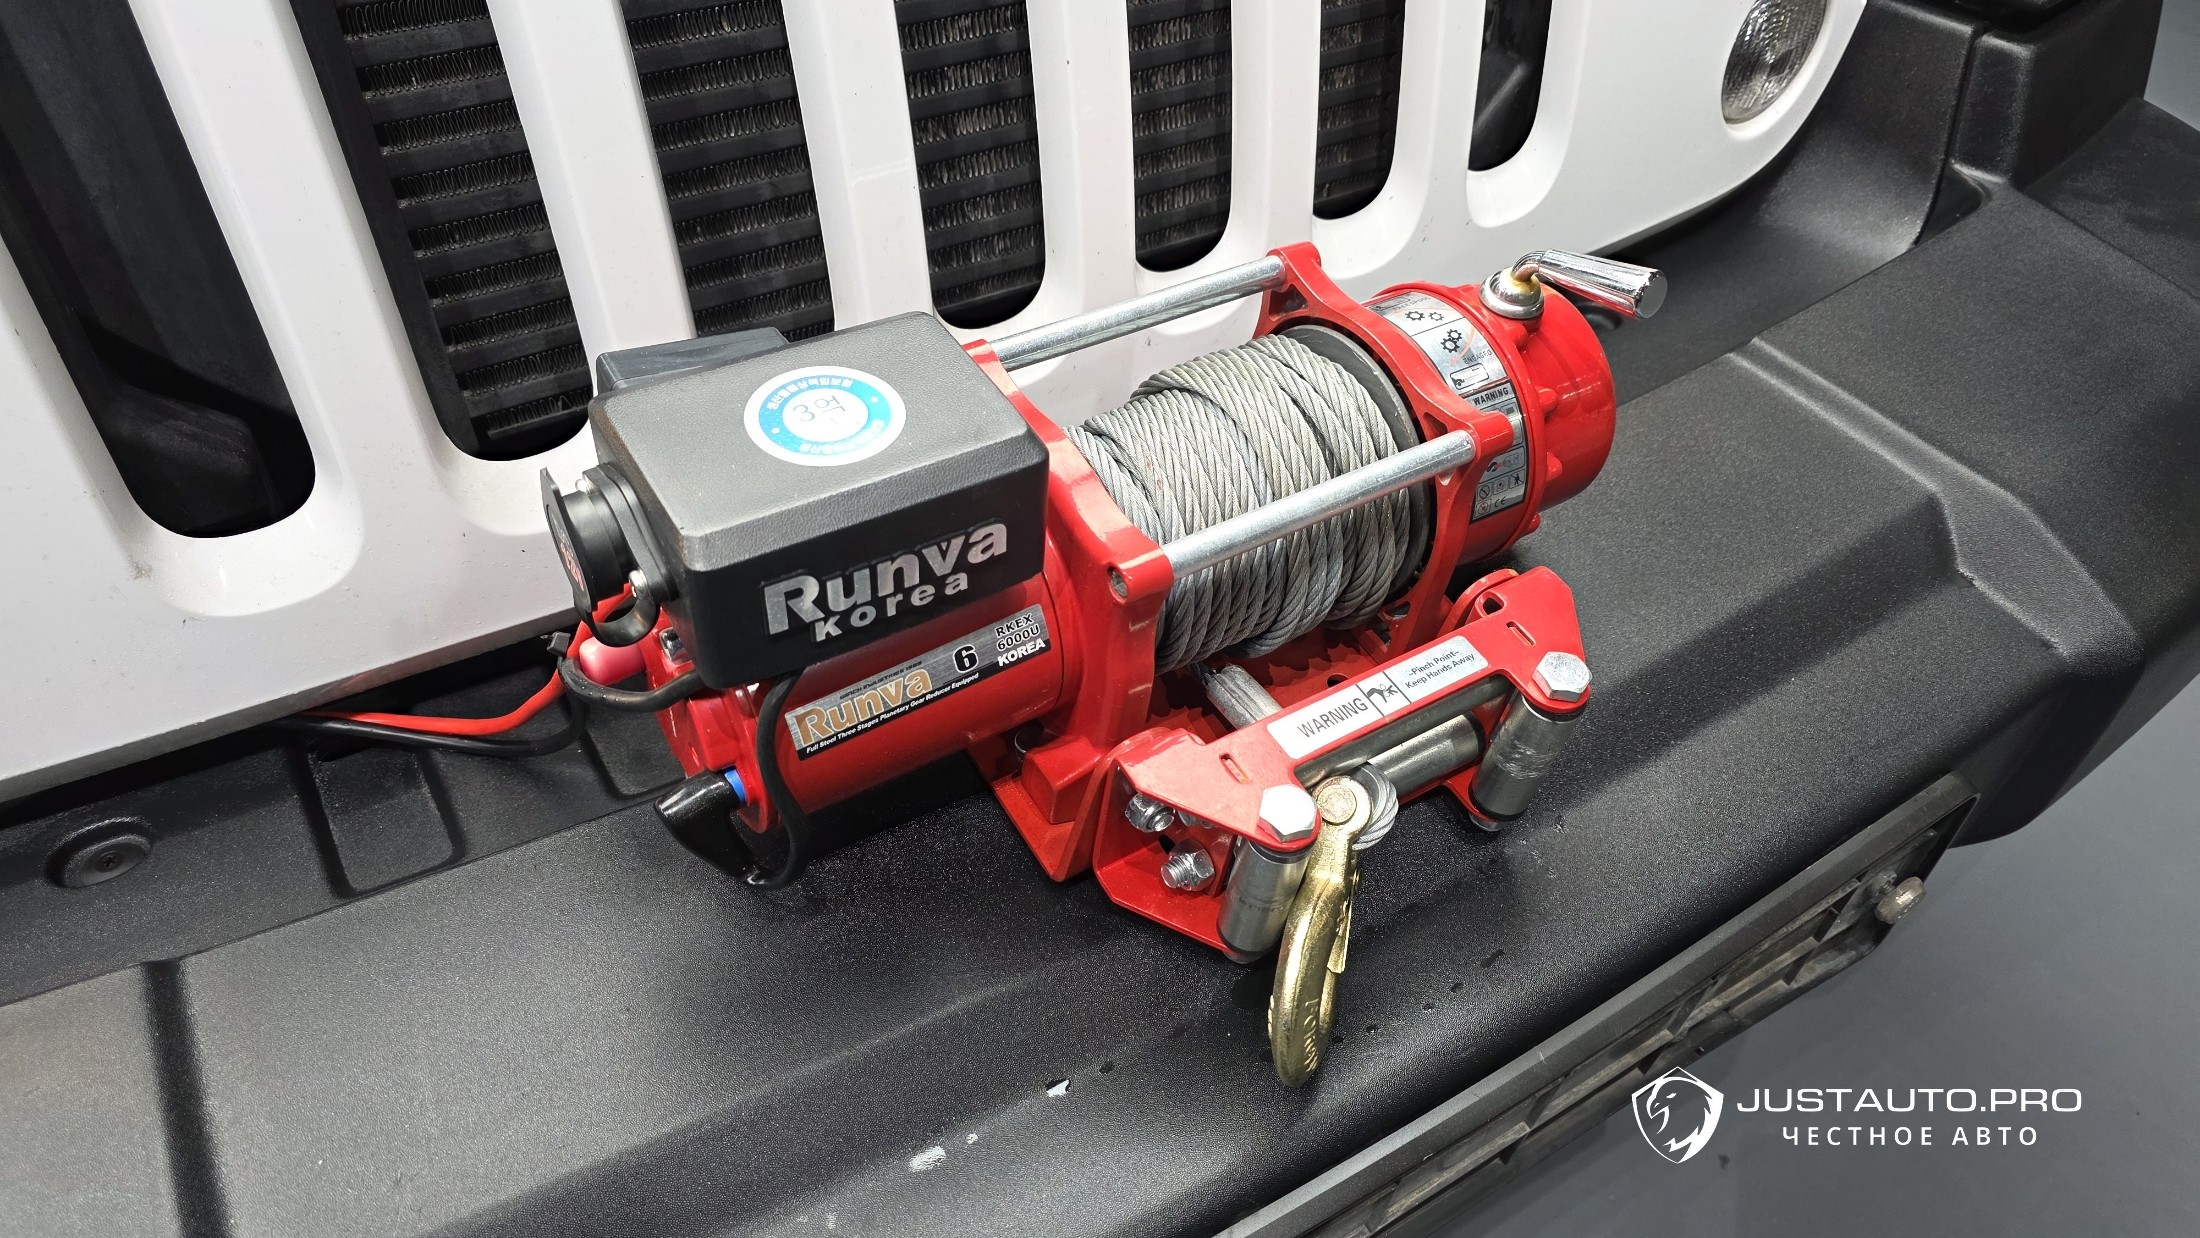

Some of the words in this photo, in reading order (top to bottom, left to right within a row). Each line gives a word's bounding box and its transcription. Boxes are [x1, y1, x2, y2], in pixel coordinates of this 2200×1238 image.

[1463, 349, 1493, 365] ENGAGED
[1473, 387, 1510, 406] WARNING
[764, 521, 1007, 636] Runva
[995, 613, 1034, 638] RKEX
[997, 624, 1040, 651] 6000U
[953, 644, 979, 673] 6
[997, 638, 1046, 666] KOREA
[1405, 676, 1428, 688] Keep
[1426, 664, 1452, 679] Hands
[1451, 653, 1475, 668] Away
[794, 669, 932, 747] Runva
[806, 744, 819, 753] Full
[819, 737, 837, 748] Steel
[837, 728, 857, 742] Three
[857, 718, 879, 732] Stages
[880, 703, 910, 721] Planetary
[910, 697, 925, 708] Gear
[926, 685, 952, 700] Reducer
[951, 672, 979, 689] Equipped
[1297, 697, 1369, 738] WARNING
